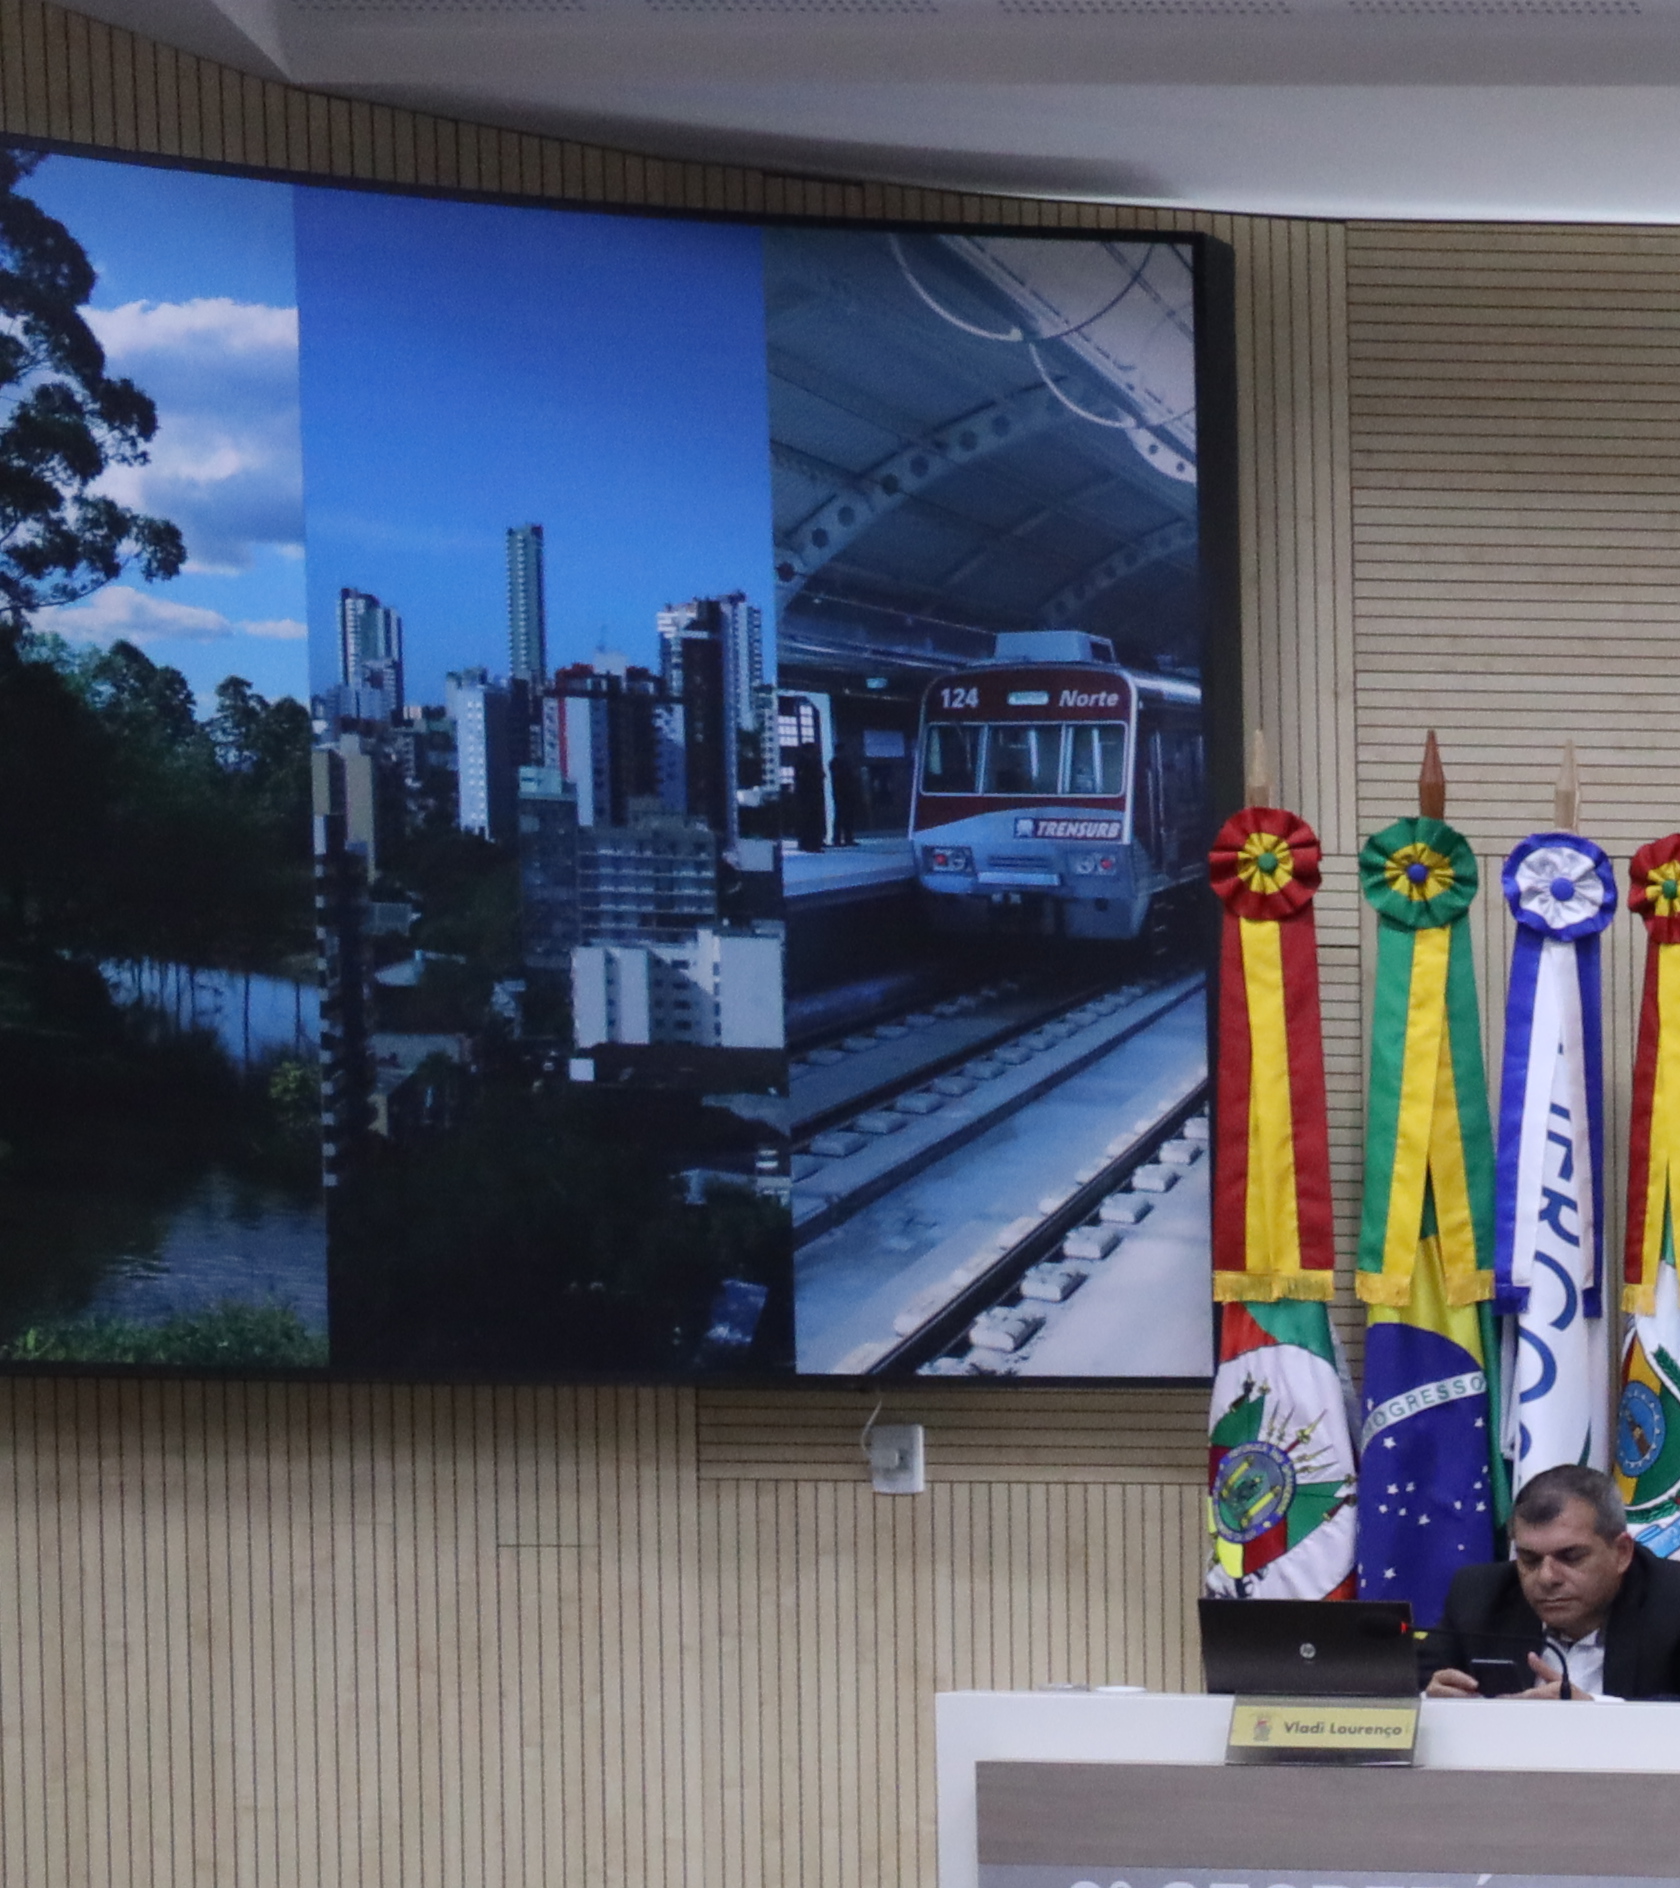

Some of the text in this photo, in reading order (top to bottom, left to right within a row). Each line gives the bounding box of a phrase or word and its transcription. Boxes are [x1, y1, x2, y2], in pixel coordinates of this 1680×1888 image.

[942, 688, 978, 708] 124
[1059, 690, 1119, 706] Norte
[1037, 821, 1121, 838] TRENSURB
[1364, 1376, 1486, 1432] OGRESSO
[1284, 1721, 1402, 1737] Vladi Lourenço
